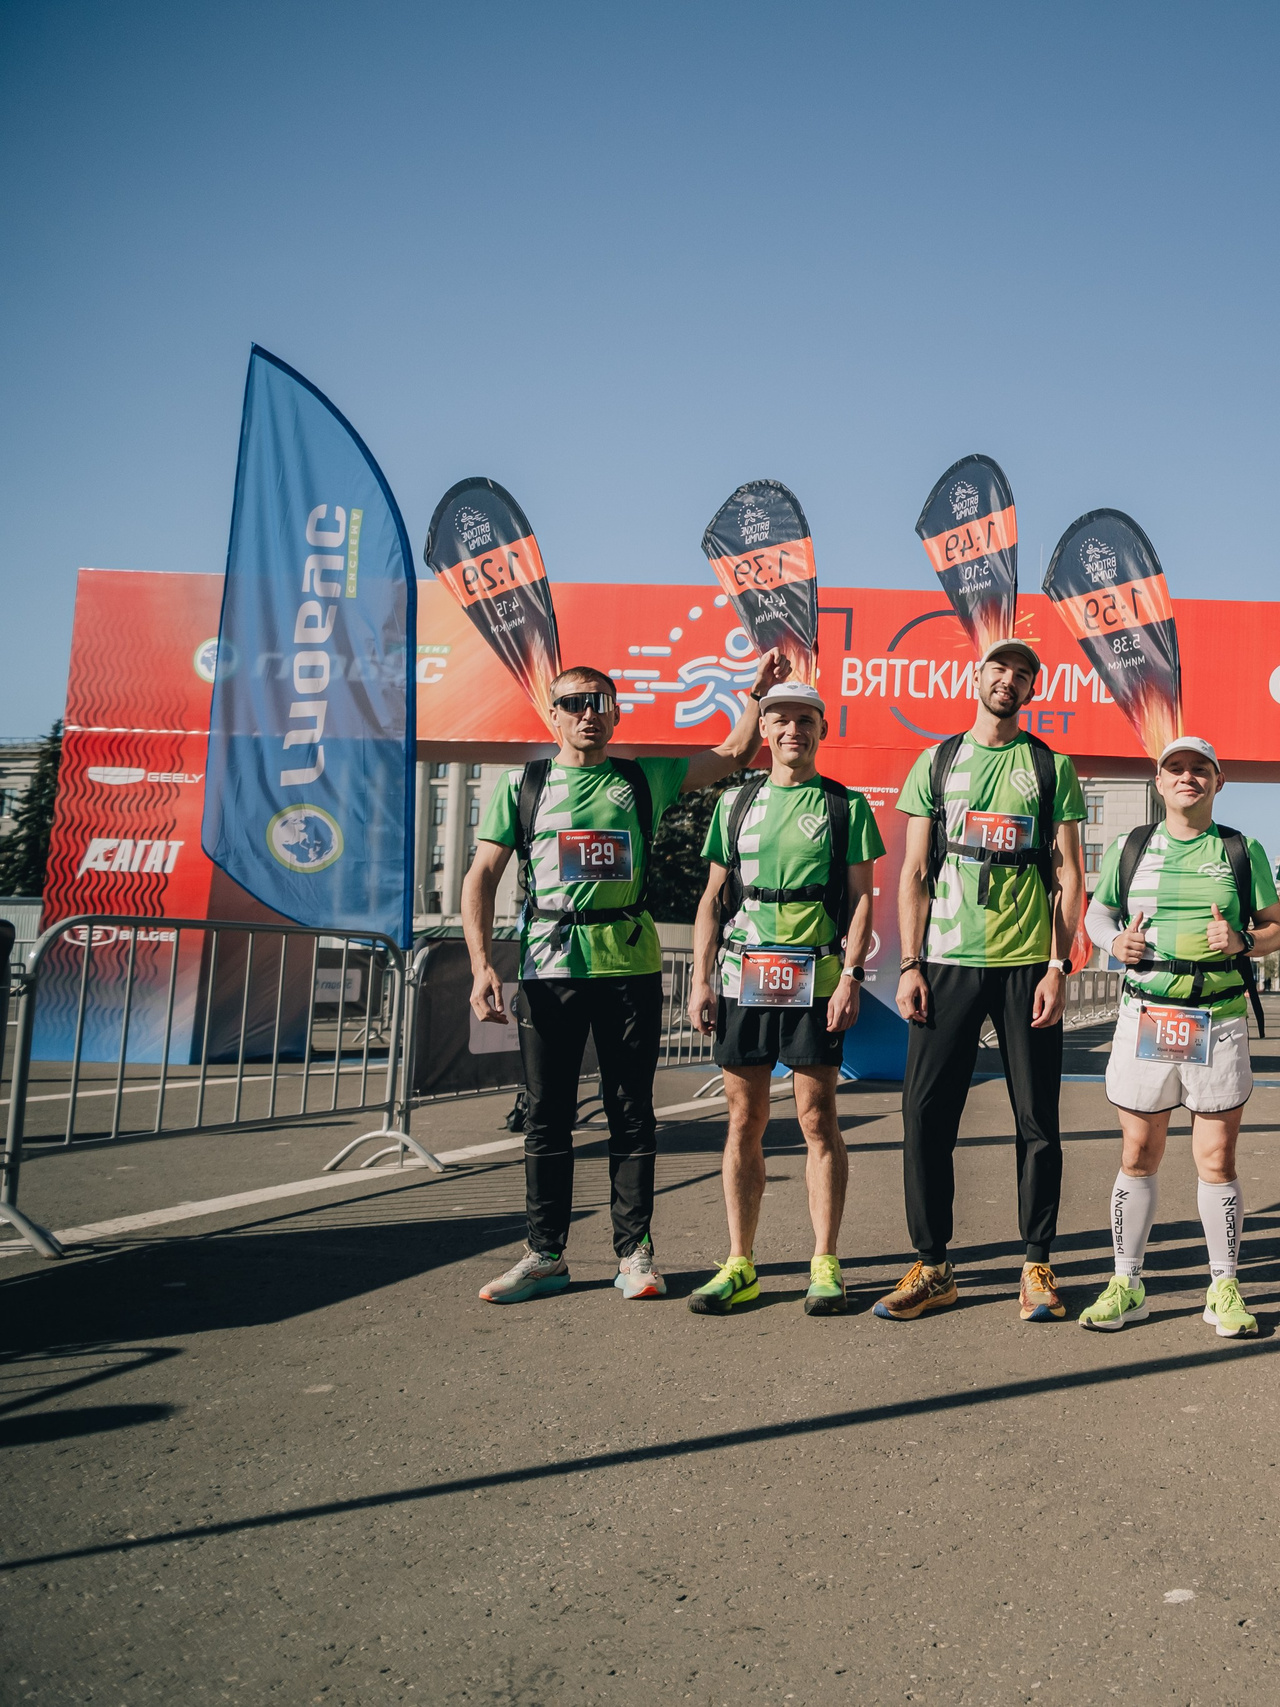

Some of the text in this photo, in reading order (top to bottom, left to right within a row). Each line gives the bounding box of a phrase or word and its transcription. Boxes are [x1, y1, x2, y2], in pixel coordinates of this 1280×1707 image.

[147, 772, 204, 784] GEELY
[982, 824, 1017, 850] 1:49
[578, 842, 615, 866] 1:29
[758, 965, 794, 990] 1:39
[1155, 1019, 1191, 1046] 1:59
[1114, 1200, 1124, 1255] NORDSKI
[1225, 1207, 1236, 1258] NORDSKI
